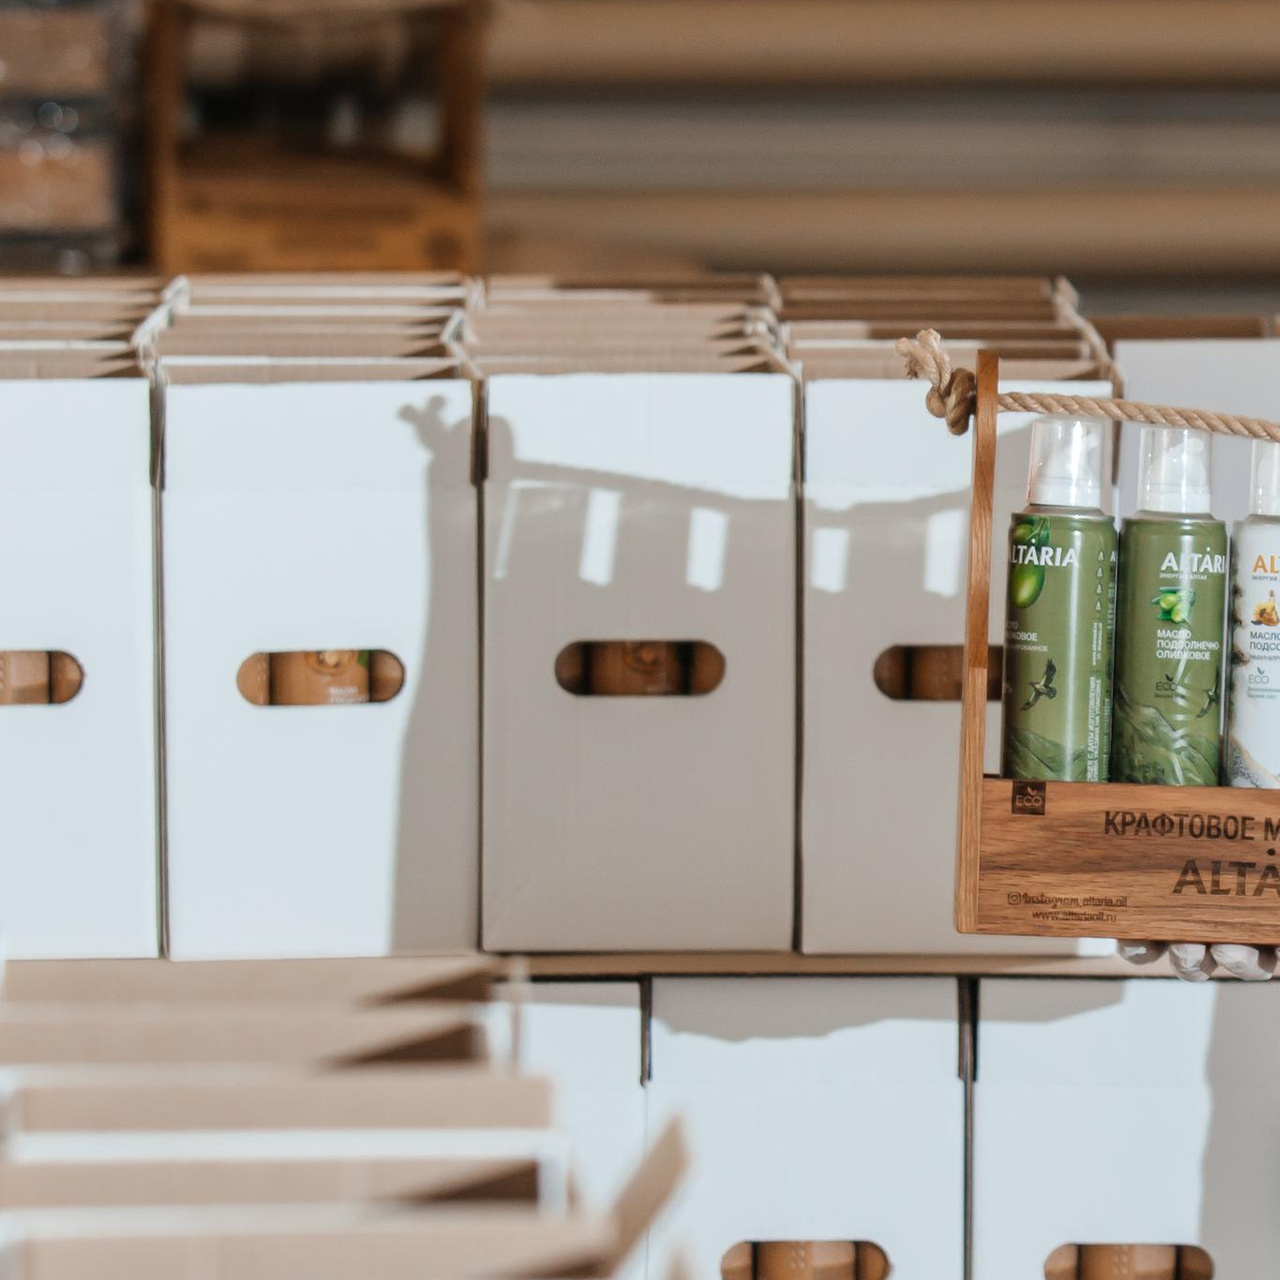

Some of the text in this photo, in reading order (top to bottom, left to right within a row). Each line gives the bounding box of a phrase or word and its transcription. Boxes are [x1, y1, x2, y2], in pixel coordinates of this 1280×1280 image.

[1010, 544, 1080, 568] LTARIA
[1160, 551, 1226, 574] ALTARI
[1248, 674, 1270, 685] ECO
[1015, 795, 1042, 808] ECO
[1104, 810, 1255, 841] КРАФТОВОЕ
